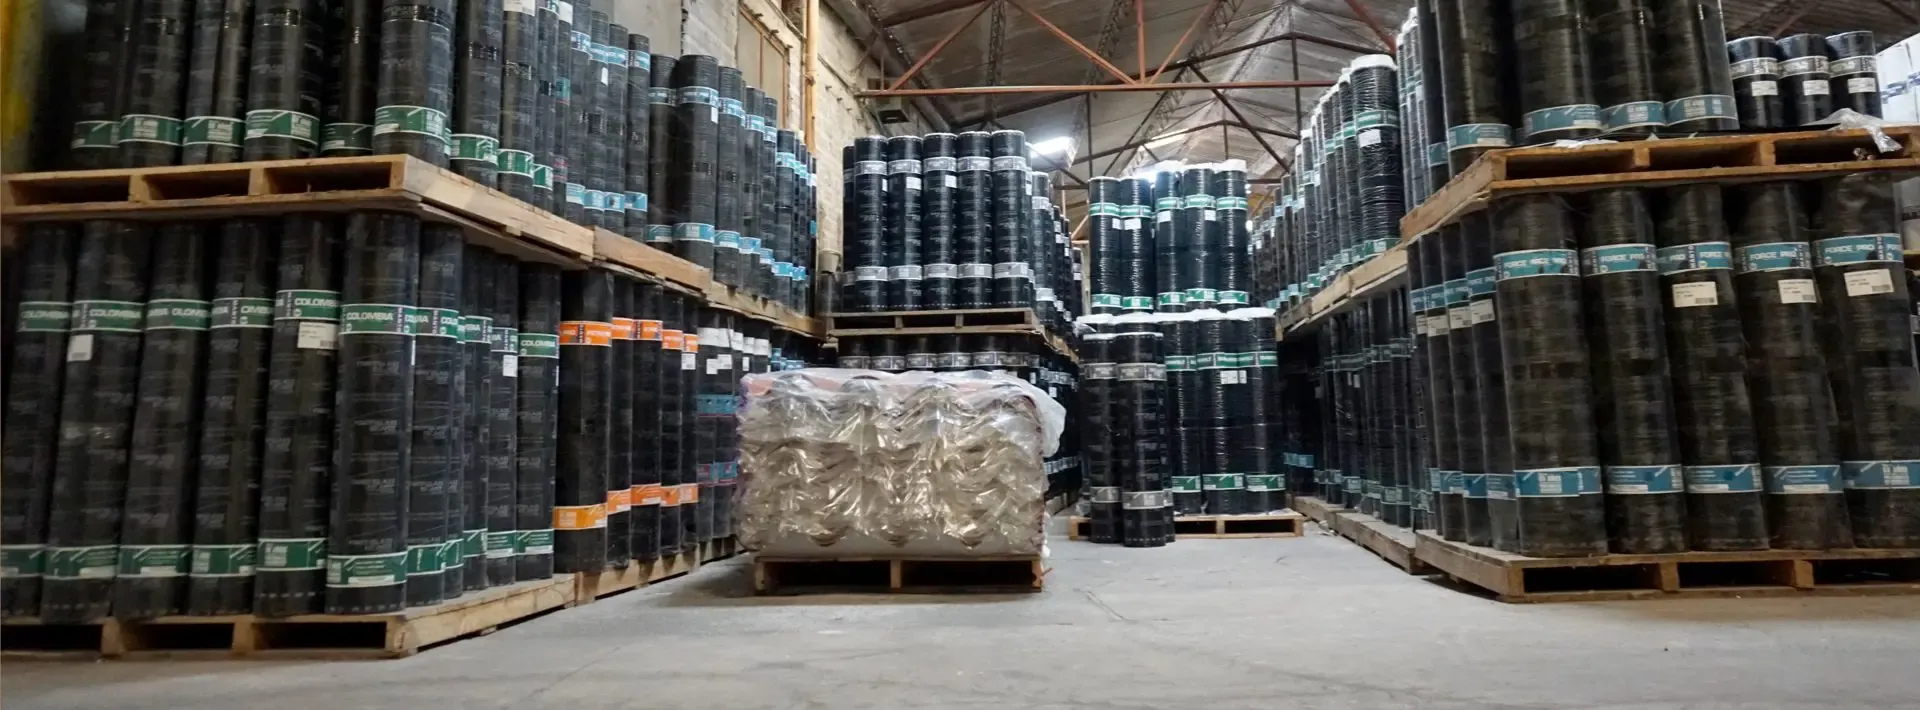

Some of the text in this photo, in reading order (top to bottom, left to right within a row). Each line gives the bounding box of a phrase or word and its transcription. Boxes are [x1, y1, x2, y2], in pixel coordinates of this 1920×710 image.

[1825, 245, 1853, 253] FORCE
[1599, 254, 1627, 263] FORCE
[1749, 252, 1777, 260] FORCE
[1503, 260, 1528, 268] FORCE
[295, 298, 337, 308] COLOMB
[346, 311, 394, 321] COLOMBIA
